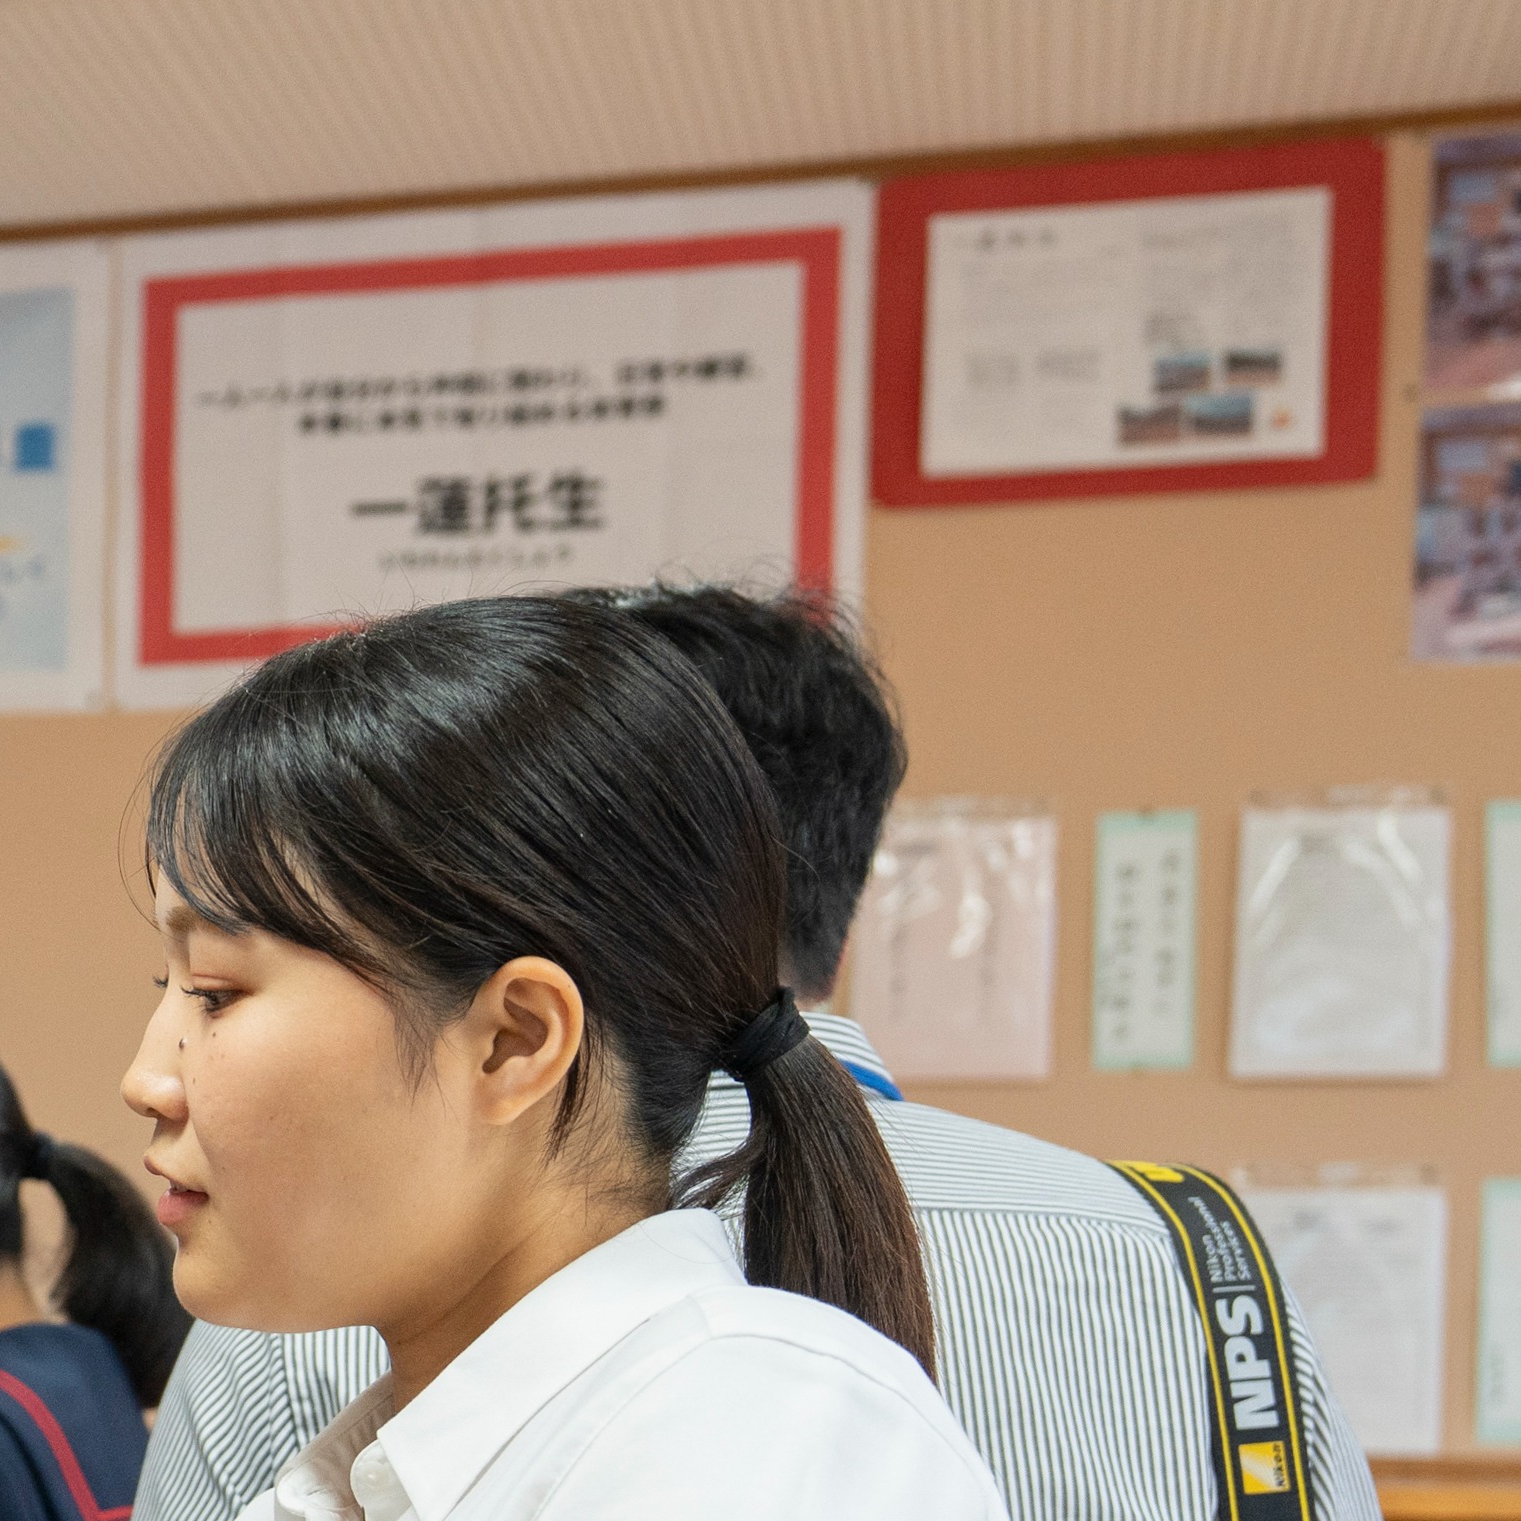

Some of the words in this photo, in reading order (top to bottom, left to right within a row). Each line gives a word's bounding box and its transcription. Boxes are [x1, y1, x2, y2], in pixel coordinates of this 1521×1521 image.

[350, 471, 605, 536] 一蓮托生
[1188, 1196, 1237, 1282] Professional
[1202, 1234, 1224, 1283] Nikon
[1220, 1220, 1253, 1281] Services
[1214, 1294, 1280, 1431] NPS
